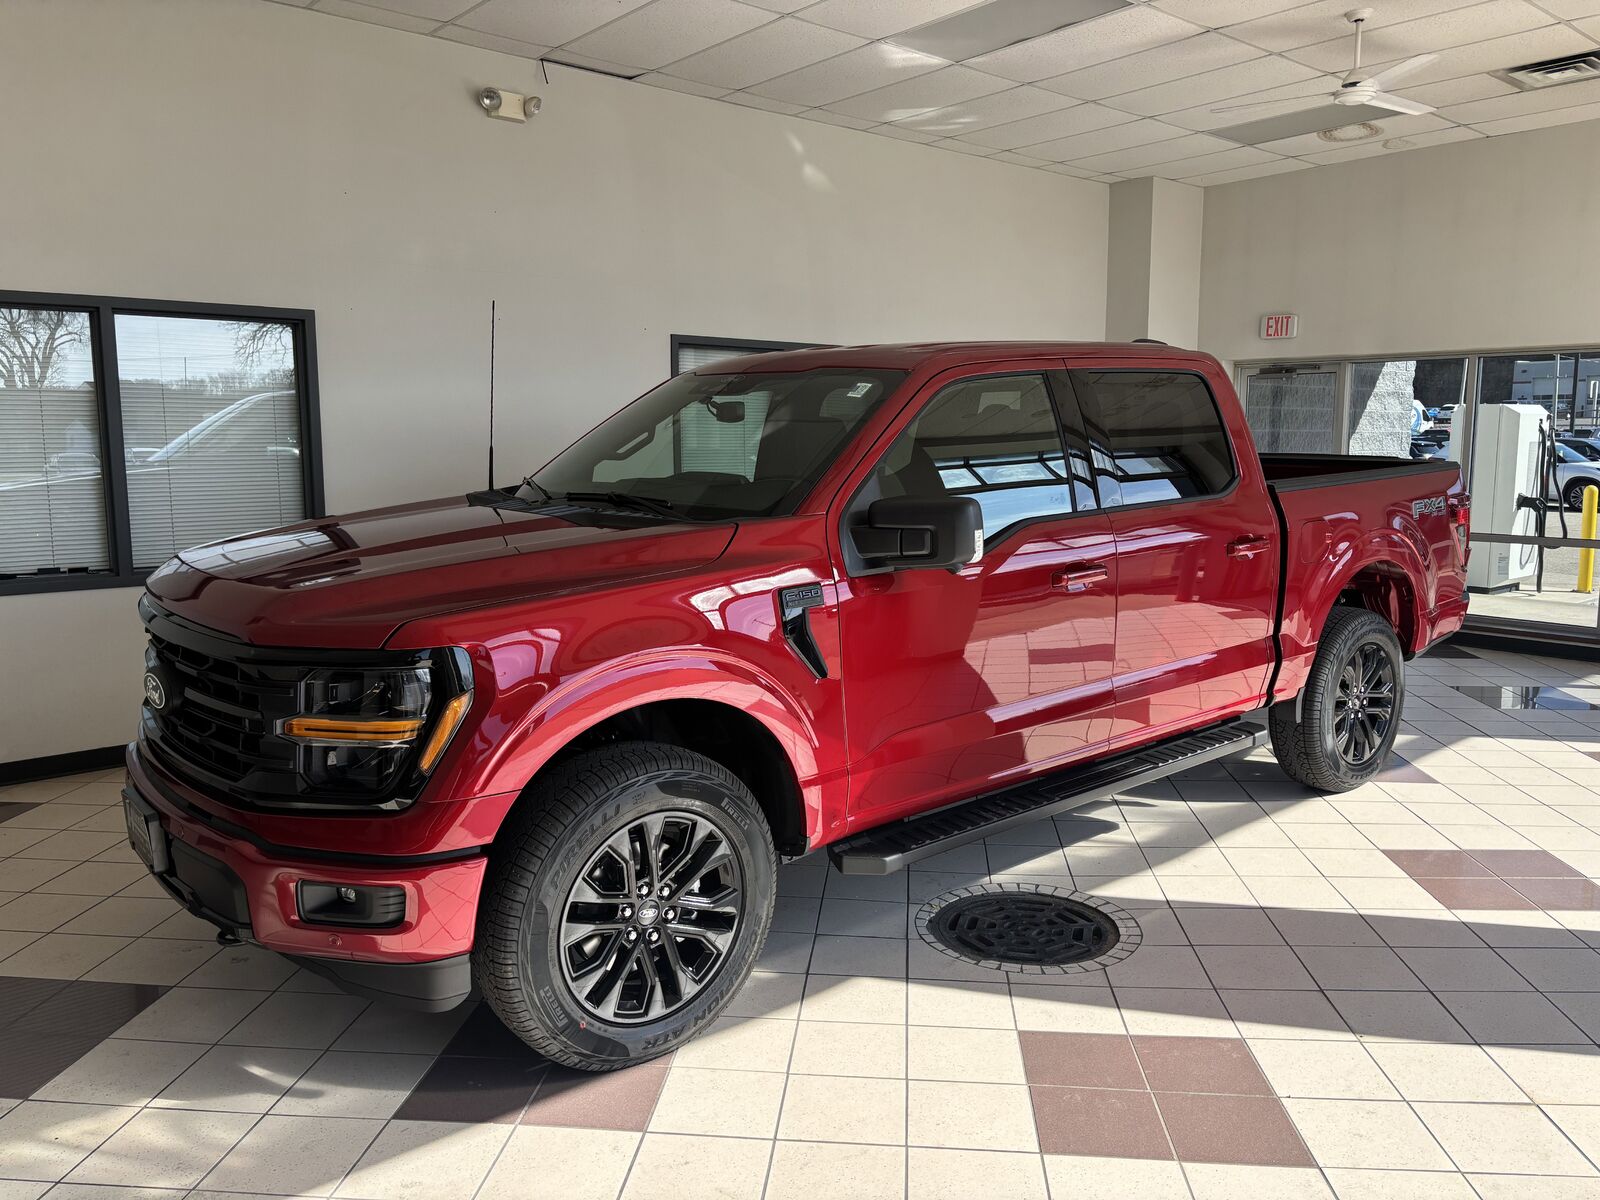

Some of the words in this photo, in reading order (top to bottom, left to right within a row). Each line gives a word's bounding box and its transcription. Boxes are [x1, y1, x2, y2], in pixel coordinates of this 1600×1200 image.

[1266, 315, 1292, 337] EXIT
[1412, 495, 1447, 520] FX4
[785, 588, 821, 601] F-150
[146, 676, 161, 705] Ford
